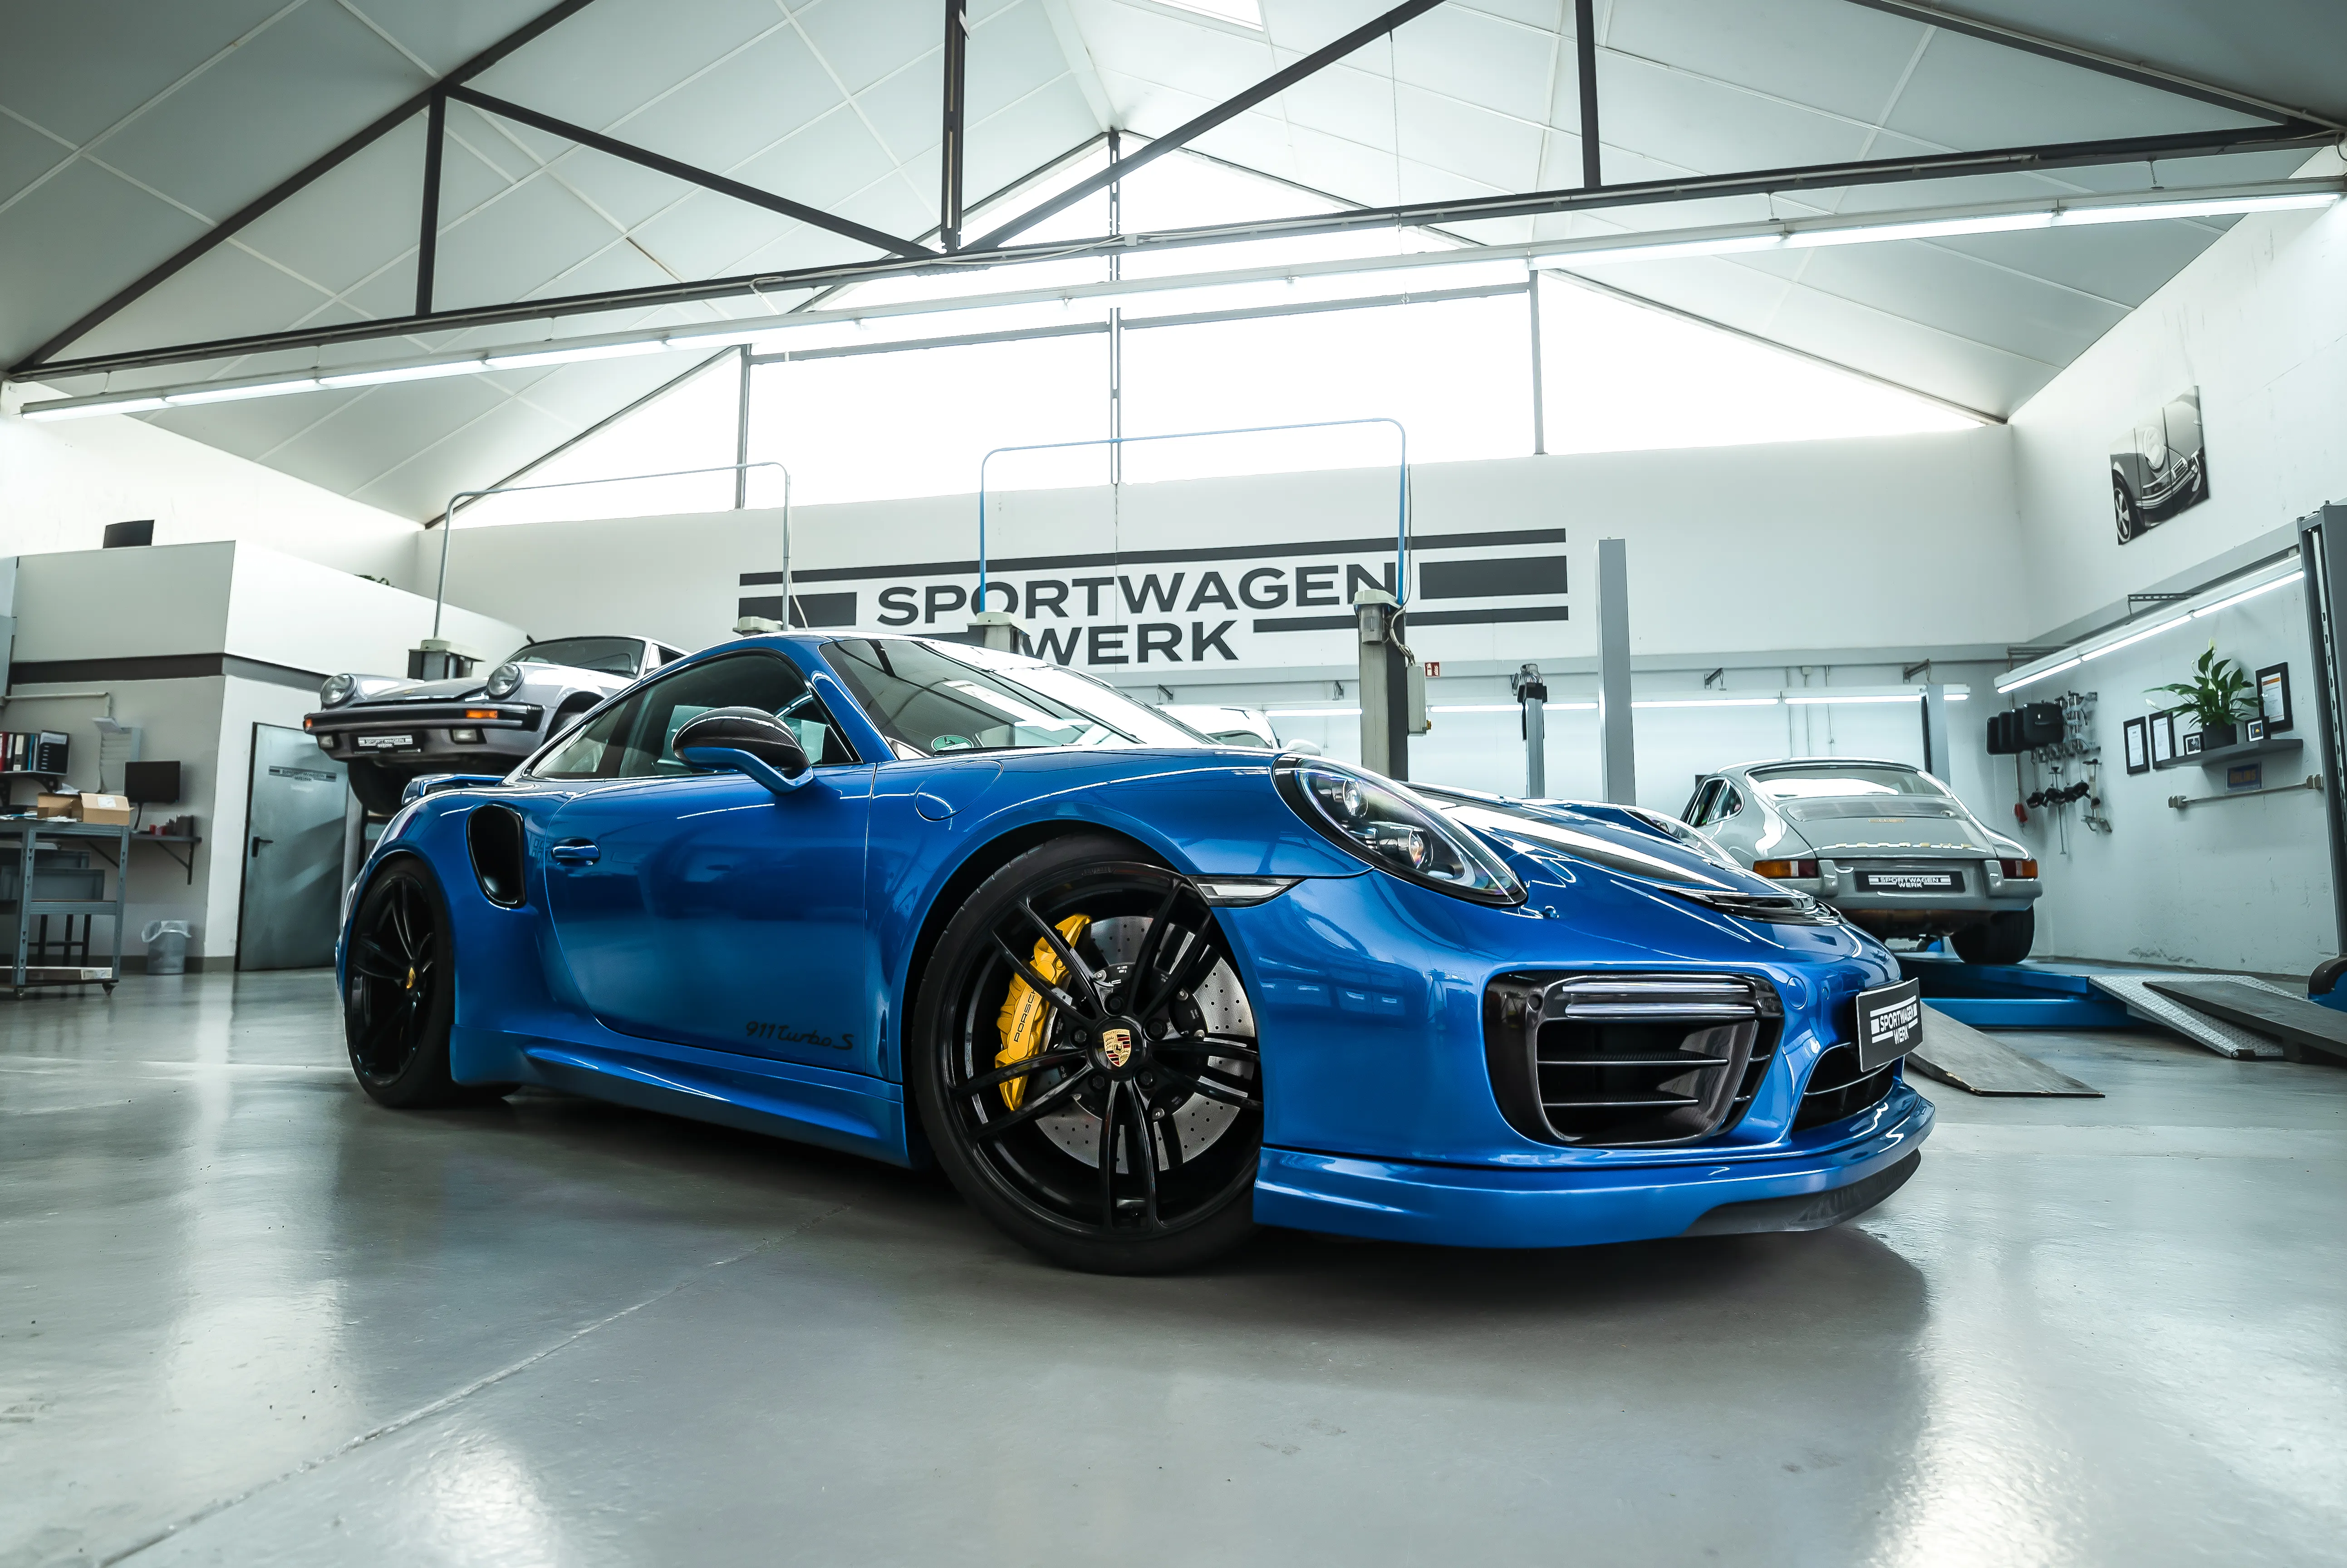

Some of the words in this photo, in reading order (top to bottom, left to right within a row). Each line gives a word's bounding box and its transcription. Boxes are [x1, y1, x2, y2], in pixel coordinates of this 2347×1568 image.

[877, 561, 1396, 626] SPORTWAGEN
[1020, 620, 1239, 666] WERK
[1014, 989, 1036, 1042] PORSC
[1880, 1004, 1914, 1032] SPORTWAGEN
[746, 1021, 776, 1039] 911
[777, 1024, 832, 1047] Turbo
[832, 1033, 854, 1050] S
[1892, 1024, 1909, 1045] WERK
